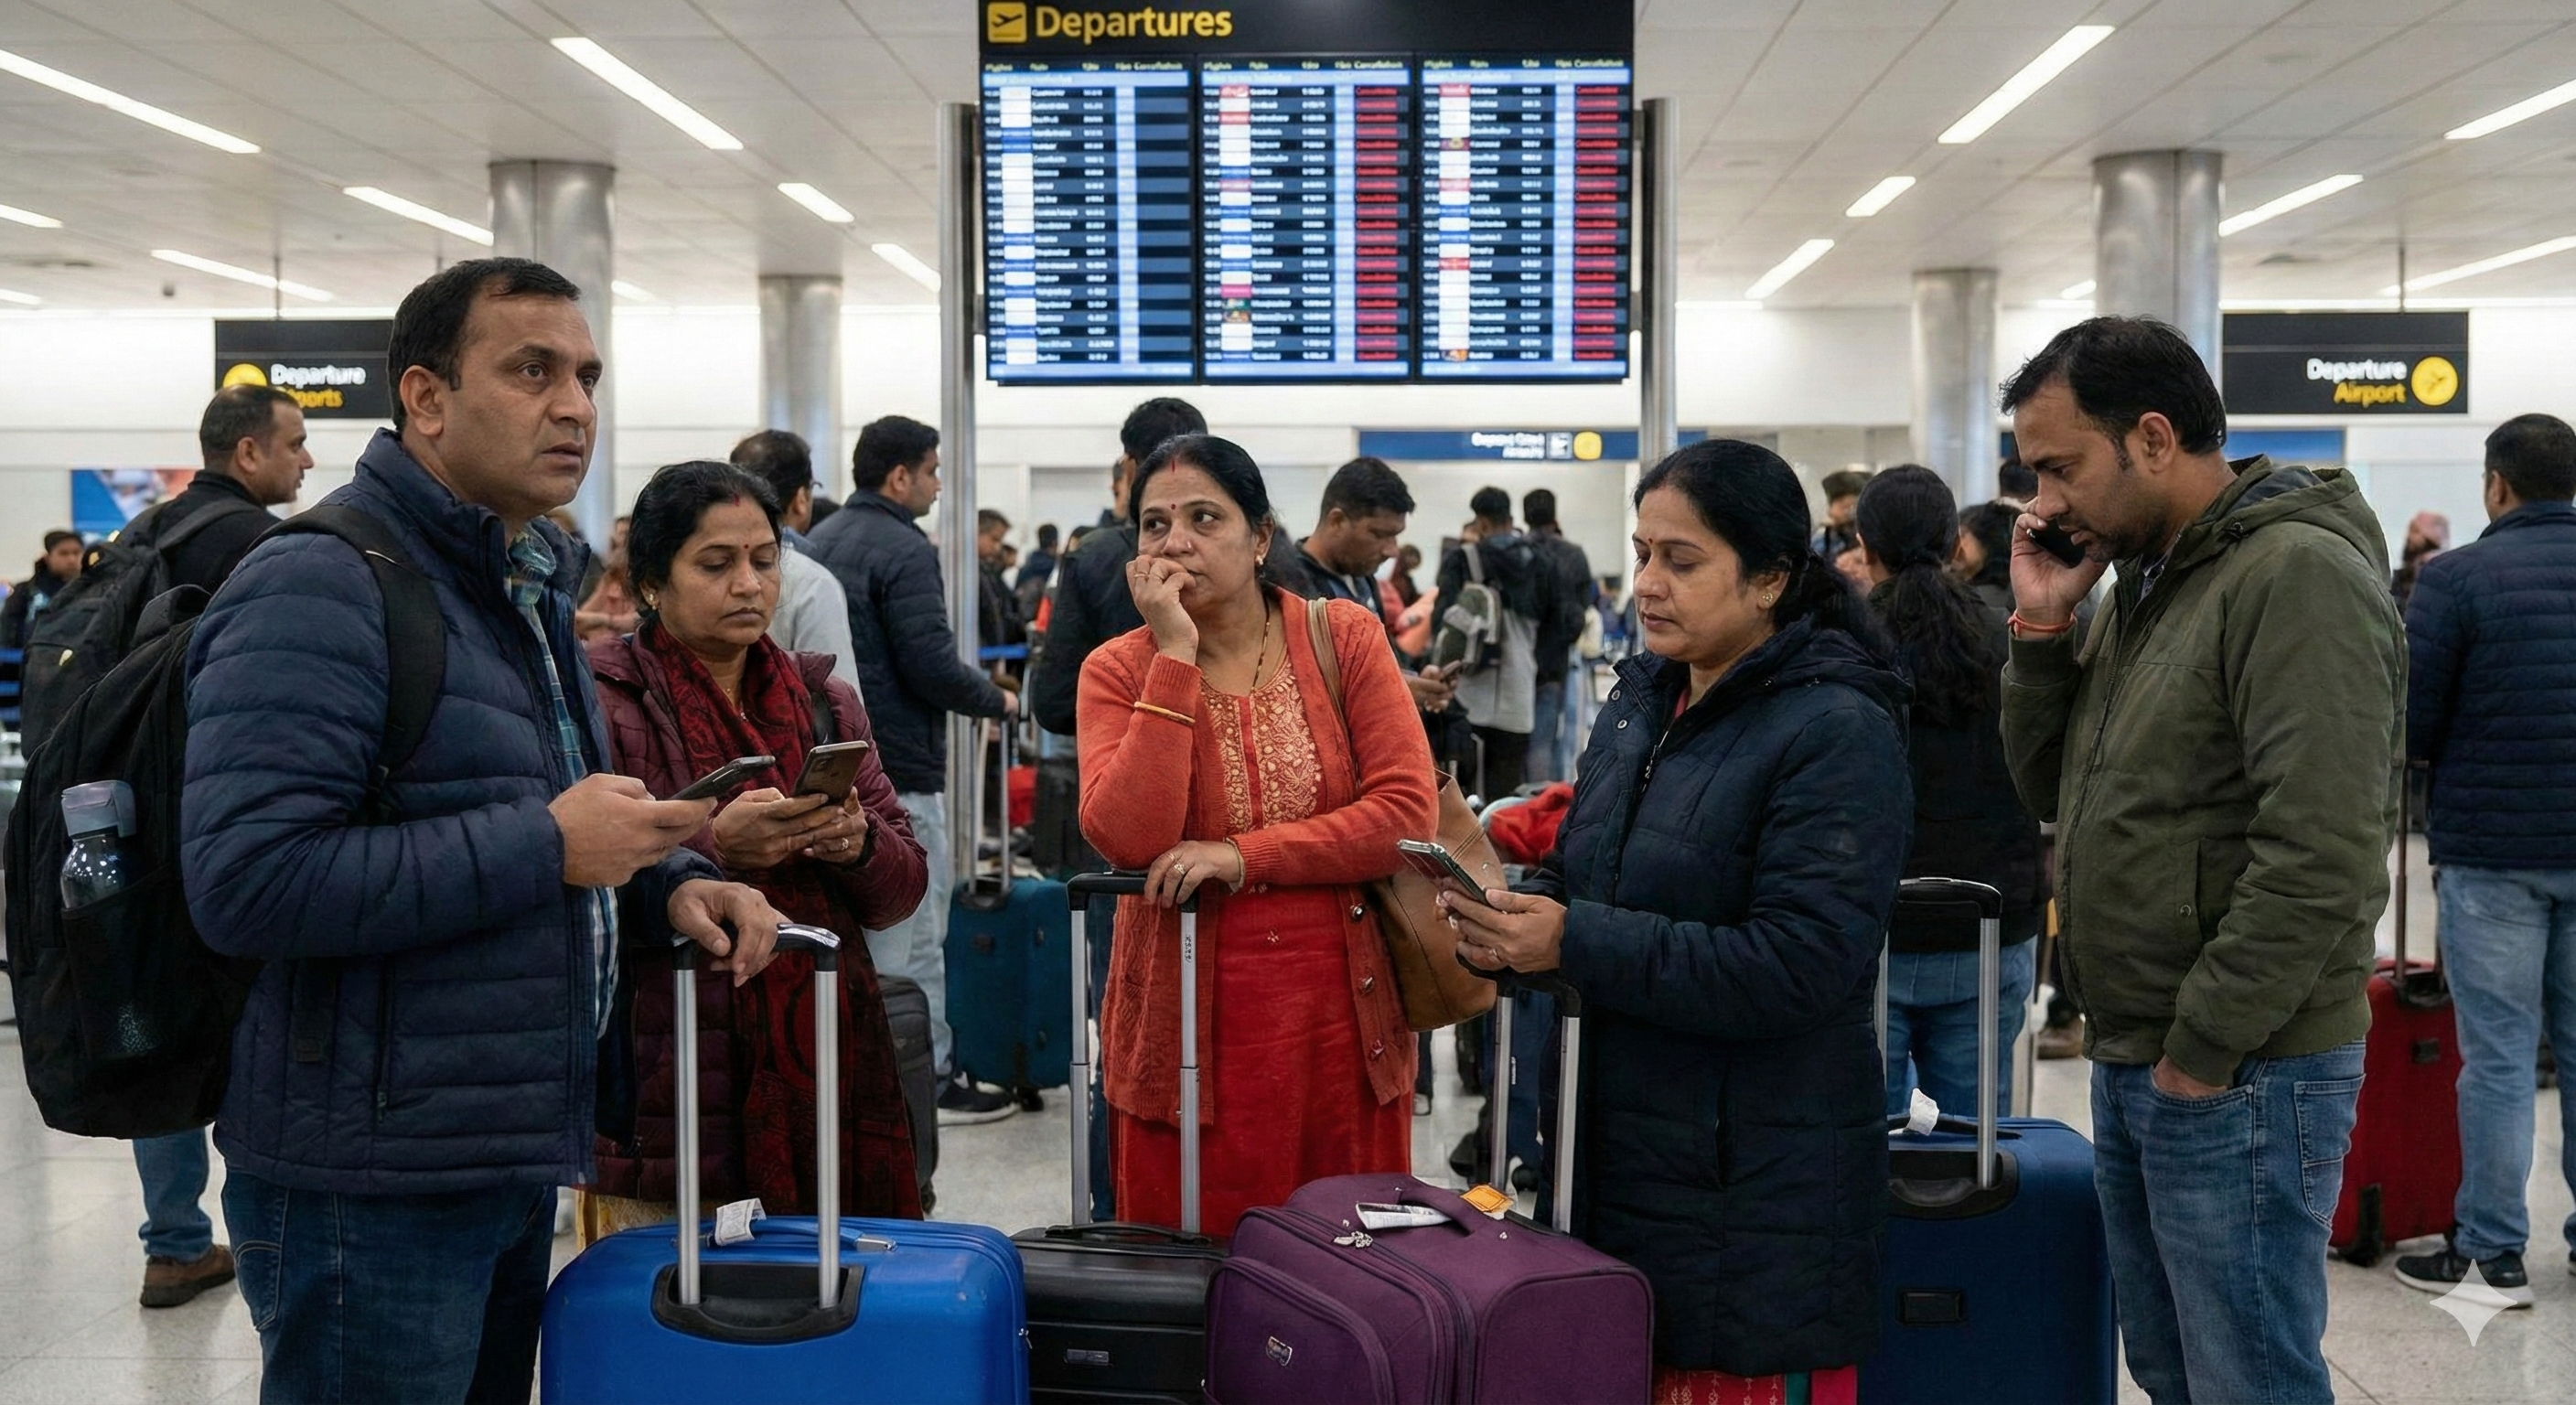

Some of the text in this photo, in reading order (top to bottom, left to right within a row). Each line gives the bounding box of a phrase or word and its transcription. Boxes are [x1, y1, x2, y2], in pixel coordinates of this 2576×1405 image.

[1036, 6, 1232, 45] Departures
[271, 363, 366, 389] Departure
[2306, 358, 2408, 384] Departure
[2334, 381, 2407, 408] Airport
